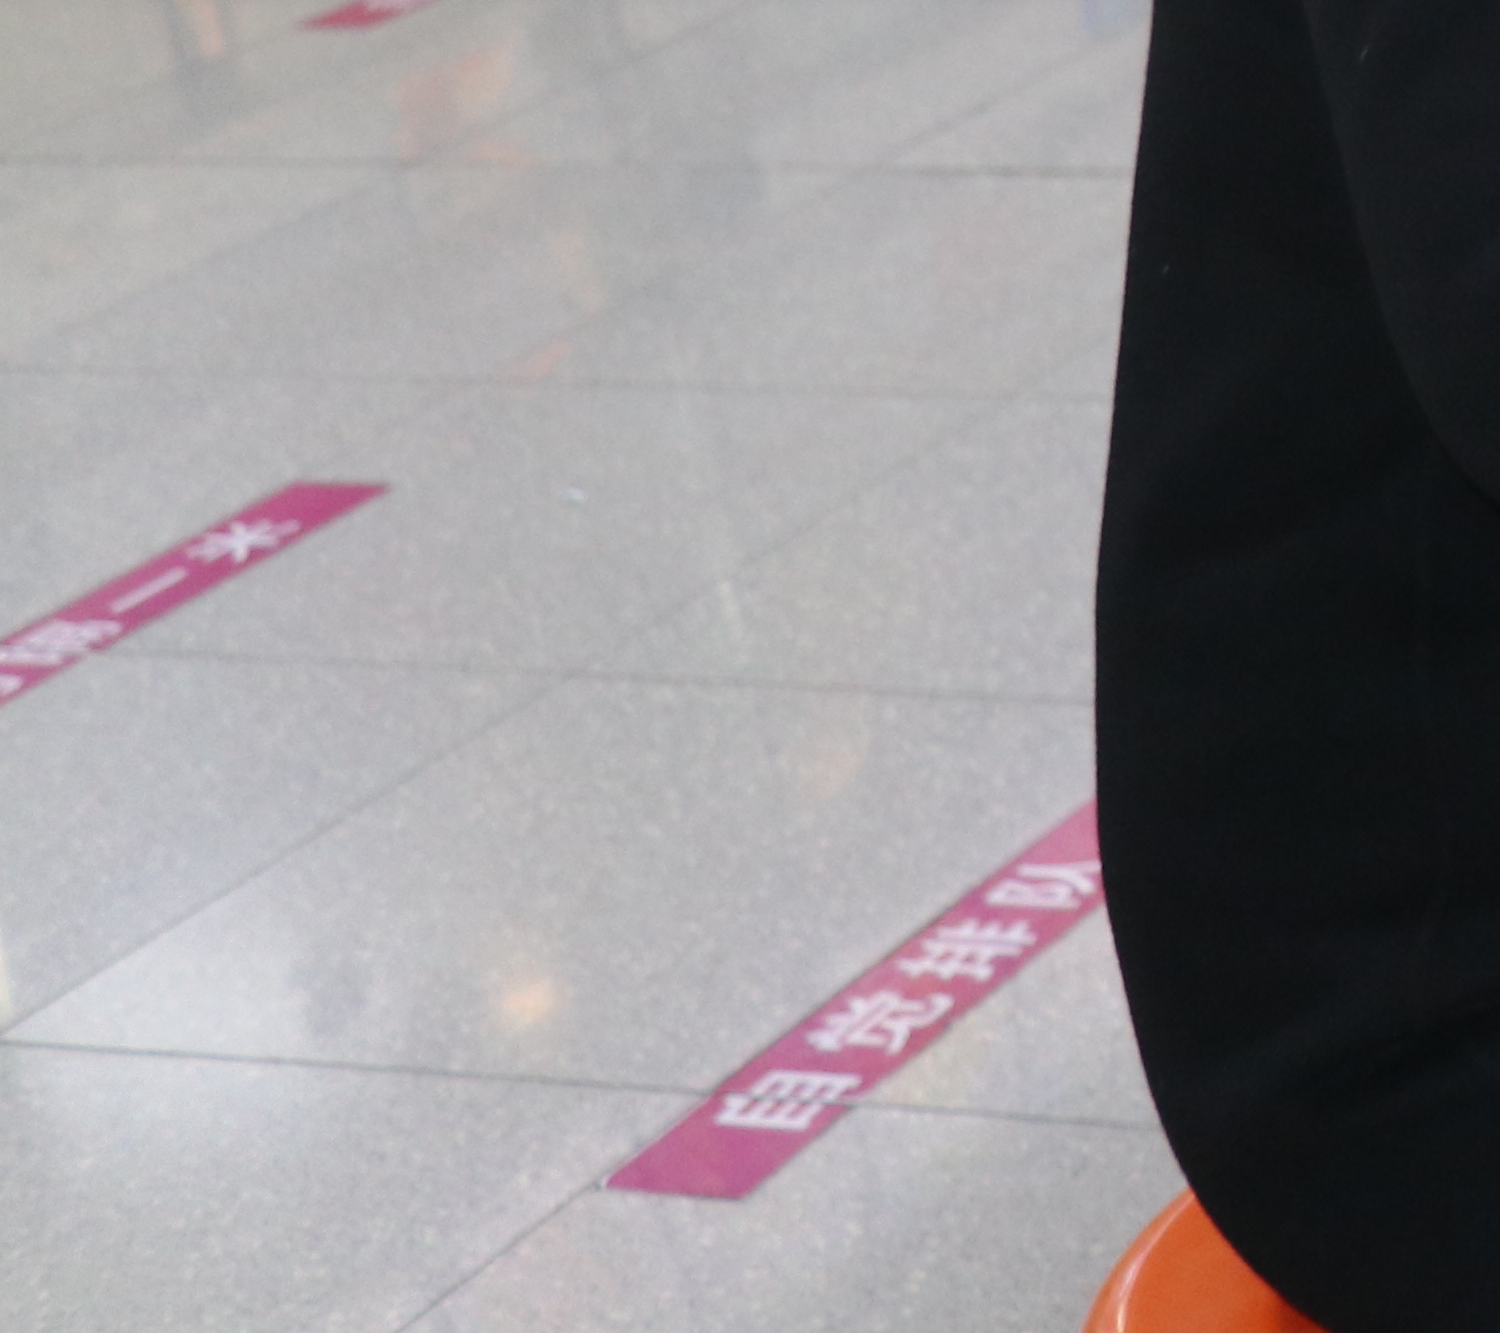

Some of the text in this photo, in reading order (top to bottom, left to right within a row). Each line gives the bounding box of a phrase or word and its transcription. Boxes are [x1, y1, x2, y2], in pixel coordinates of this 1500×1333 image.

[0, 519, 300, 696] 隔一米
[714, 859, 1102, 1130] 自觉排队
